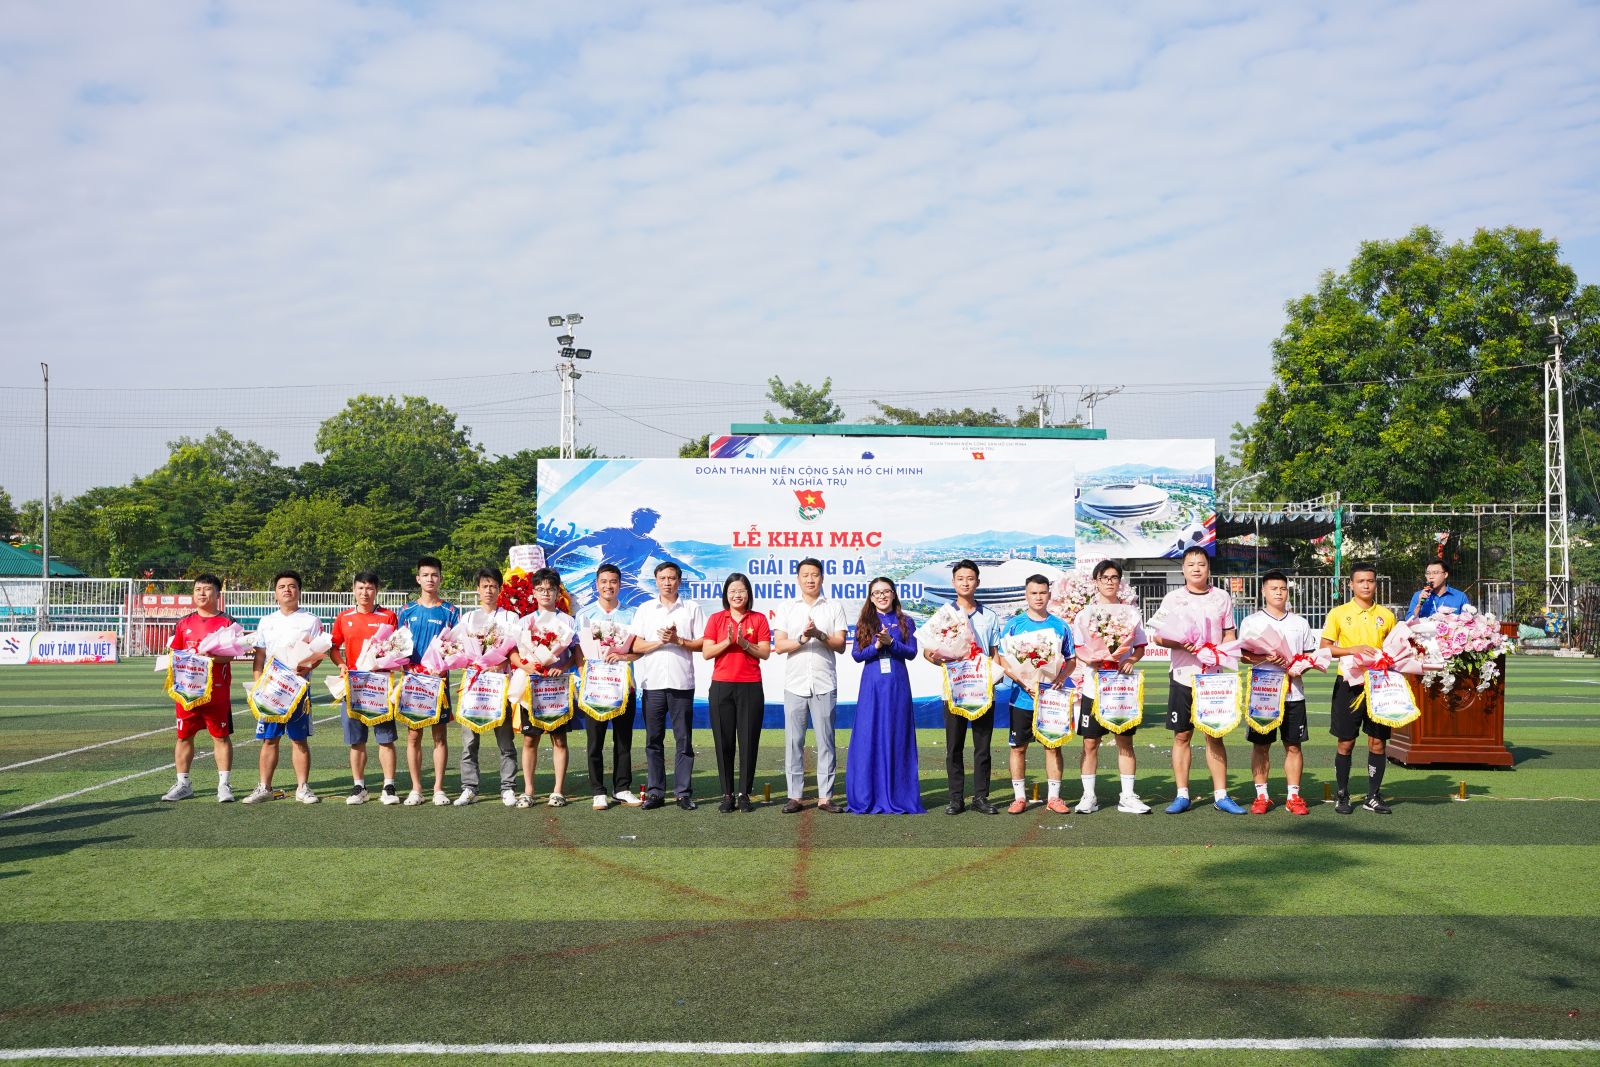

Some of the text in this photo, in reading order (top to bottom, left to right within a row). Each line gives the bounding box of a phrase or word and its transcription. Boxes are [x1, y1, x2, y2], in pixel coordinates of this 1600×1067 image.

[695, 464, 923, 478] ĐOÀN THANH NIÊN CỘNG SẢN HỒ CHÍ MINH
[772, 476, 847, 488] XÃ NGHĨA TRỤ
[733, 524, 882, 551] LỄ KHAI MẠC
[749, 554, 866, 575] GIẢI BG ĐÁ
[691, 583, 723, 599] THA
[755, 579, 796, 599] NIÊN
[831, 582, 867, 599] NGH
[58, 641, 76, 656] TÂM
[93, 641, 112, 656] VIỆT
[1145, 648, 1169, 657] OPARK
[1171, 711, 1178, 723] 3
